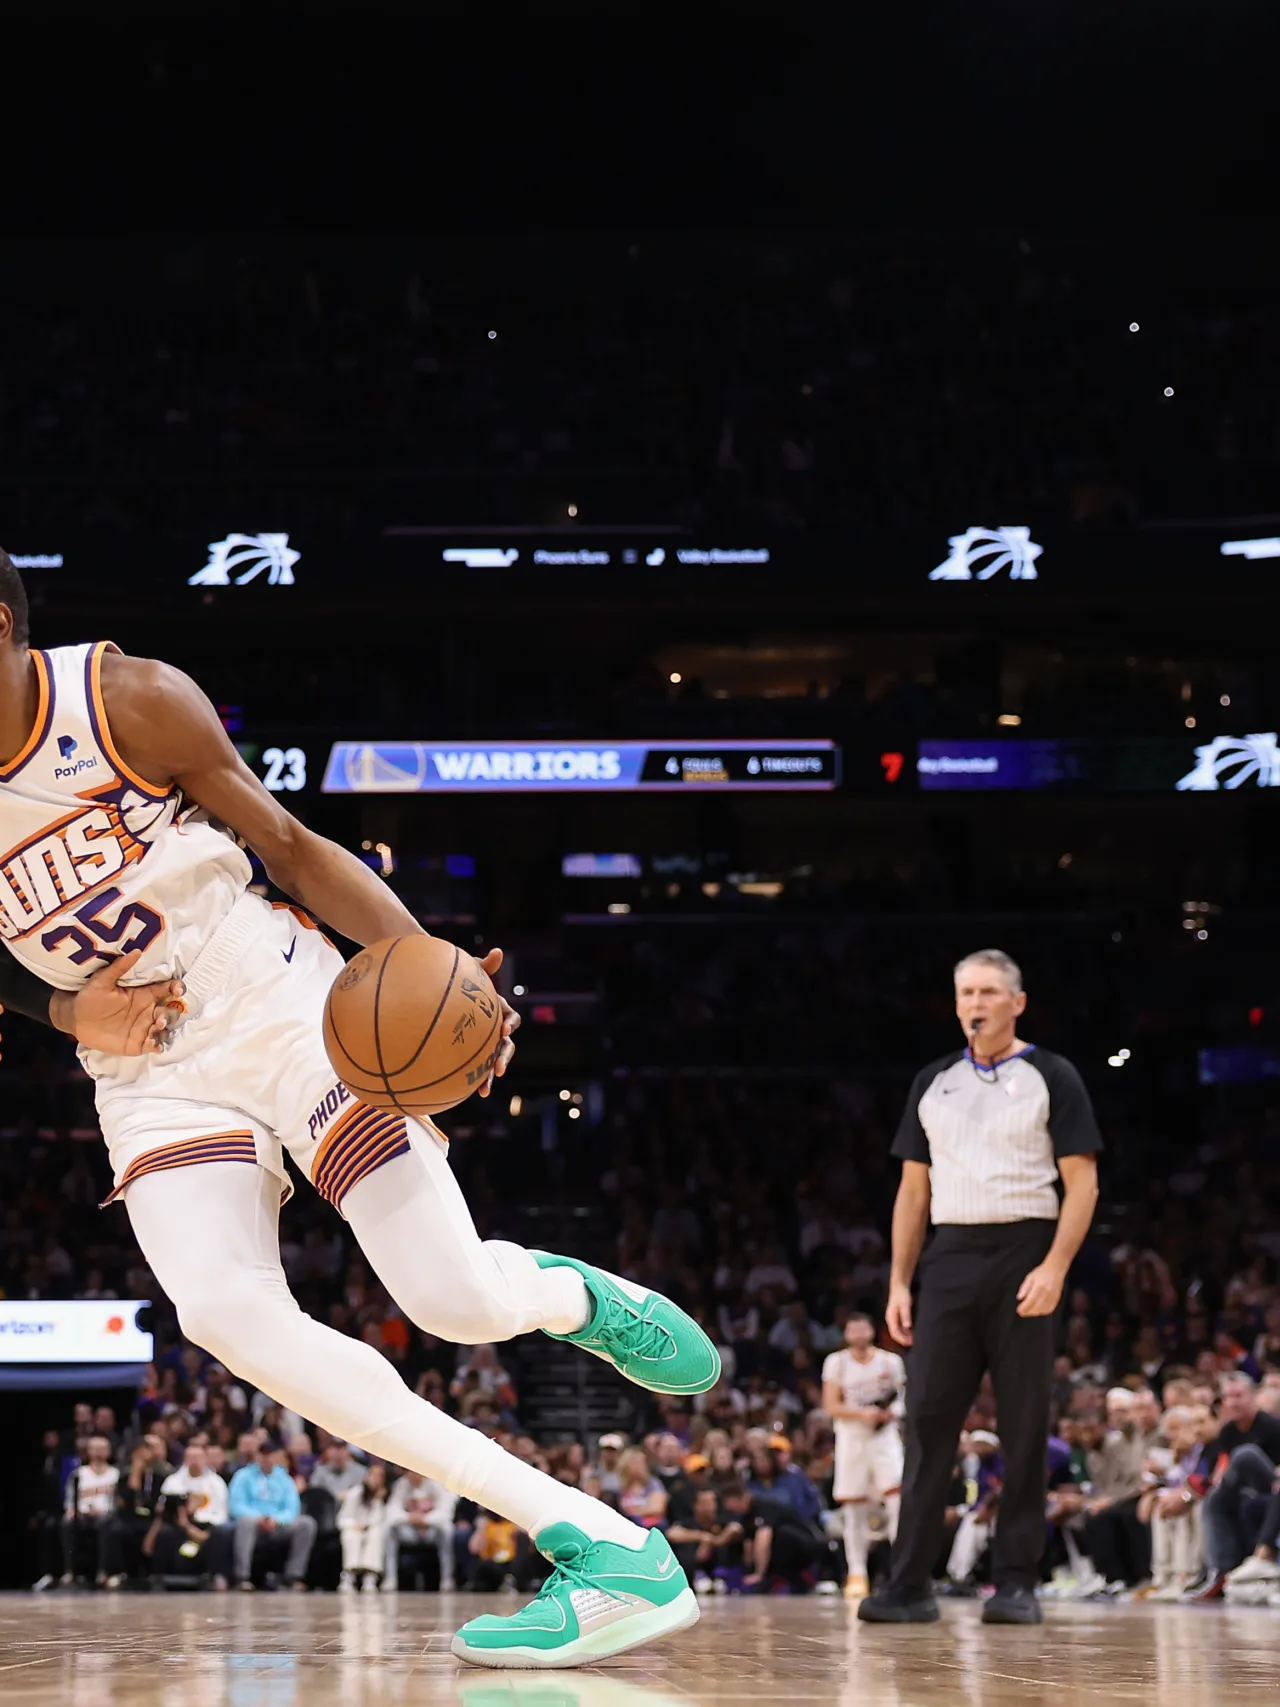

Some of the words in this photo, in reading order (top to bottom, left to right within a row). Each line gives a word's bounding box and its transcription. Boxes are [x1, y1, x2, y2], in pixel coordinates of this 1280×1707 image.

[54, 756, 98, 780] PayPal
[262, 748, 307, 792] 23
[432, 752, 621, 781] WARRIORS
[880, 752, 904, 783] 7
[41, 886, 165, 979] 35
[308, 1081, 352, 1141] PHOE
